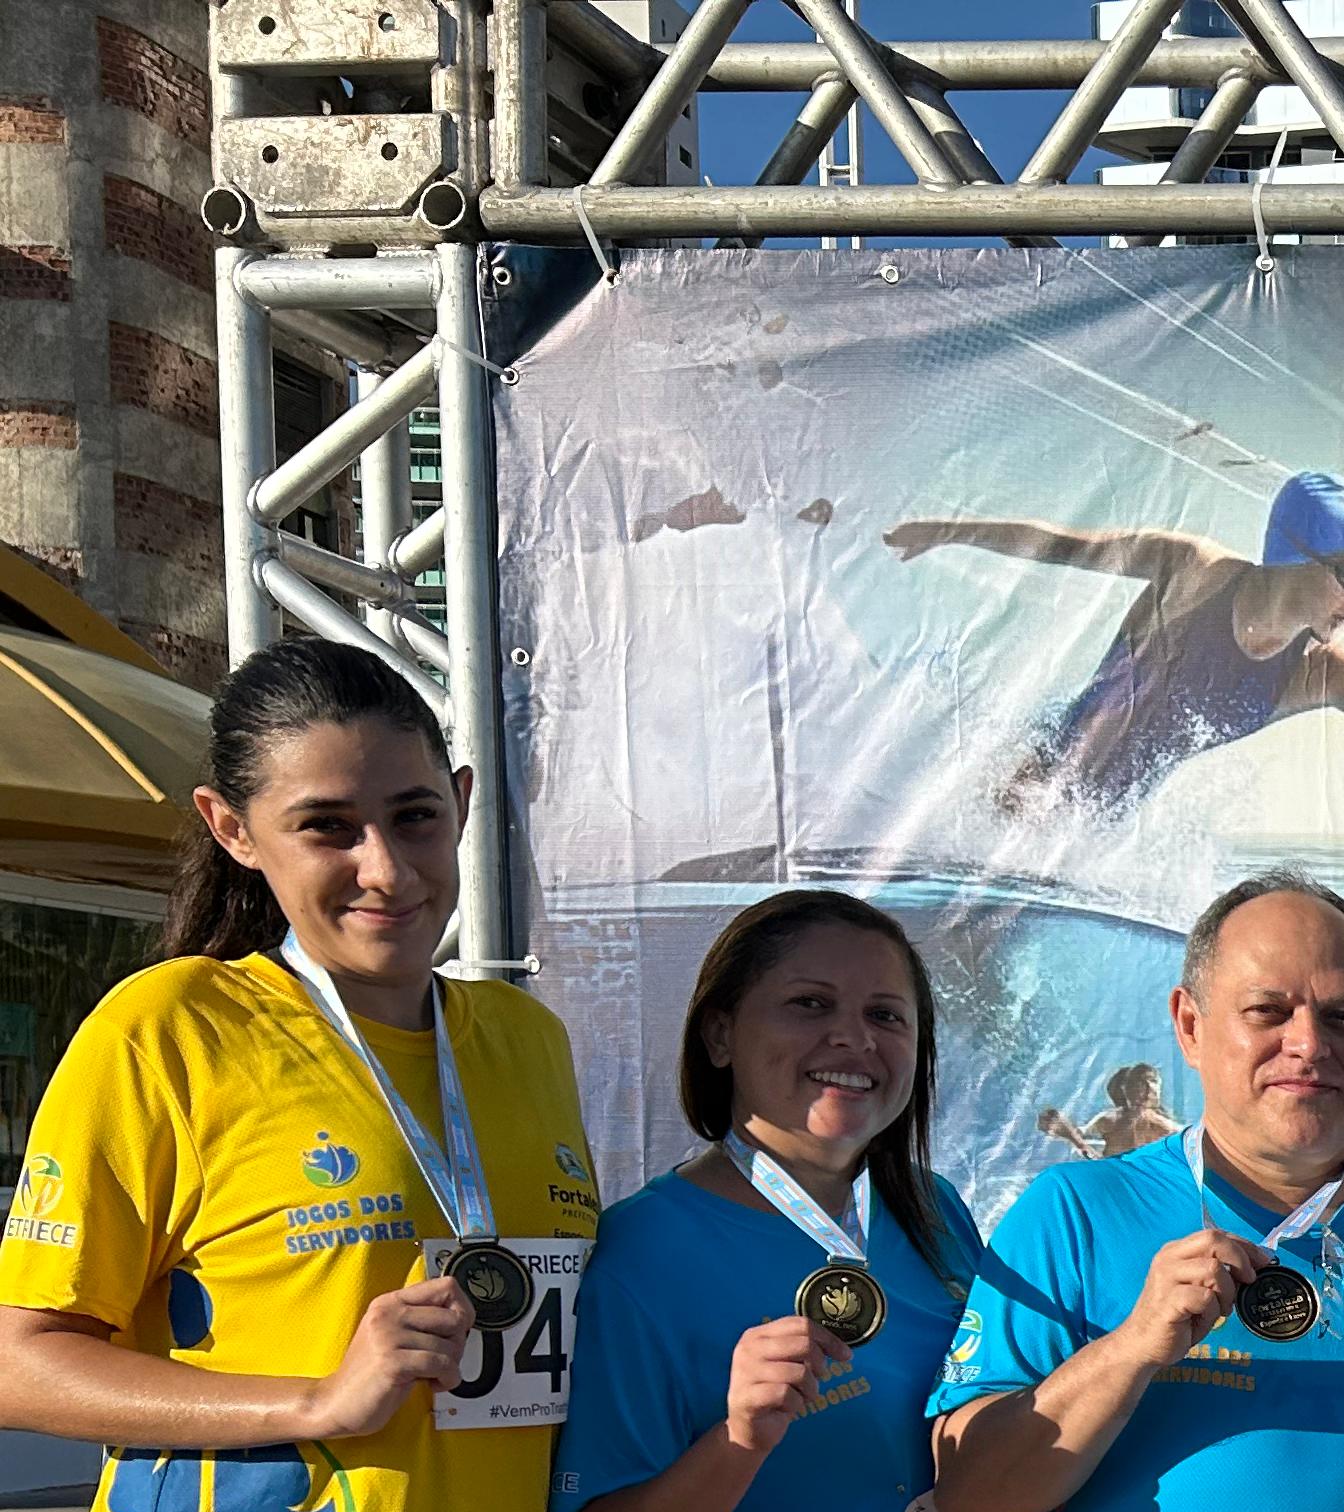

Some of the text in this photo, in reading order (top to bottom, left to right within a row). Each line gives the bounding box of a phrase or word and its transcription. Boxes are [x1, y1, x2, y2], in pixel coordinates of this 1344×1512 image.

[287, 1193, 403, 1228] JOGOS DOS
[286, 1220, 415, 1254] SERVIDORES
[1218, 1346, 1252, 1367] DOS
